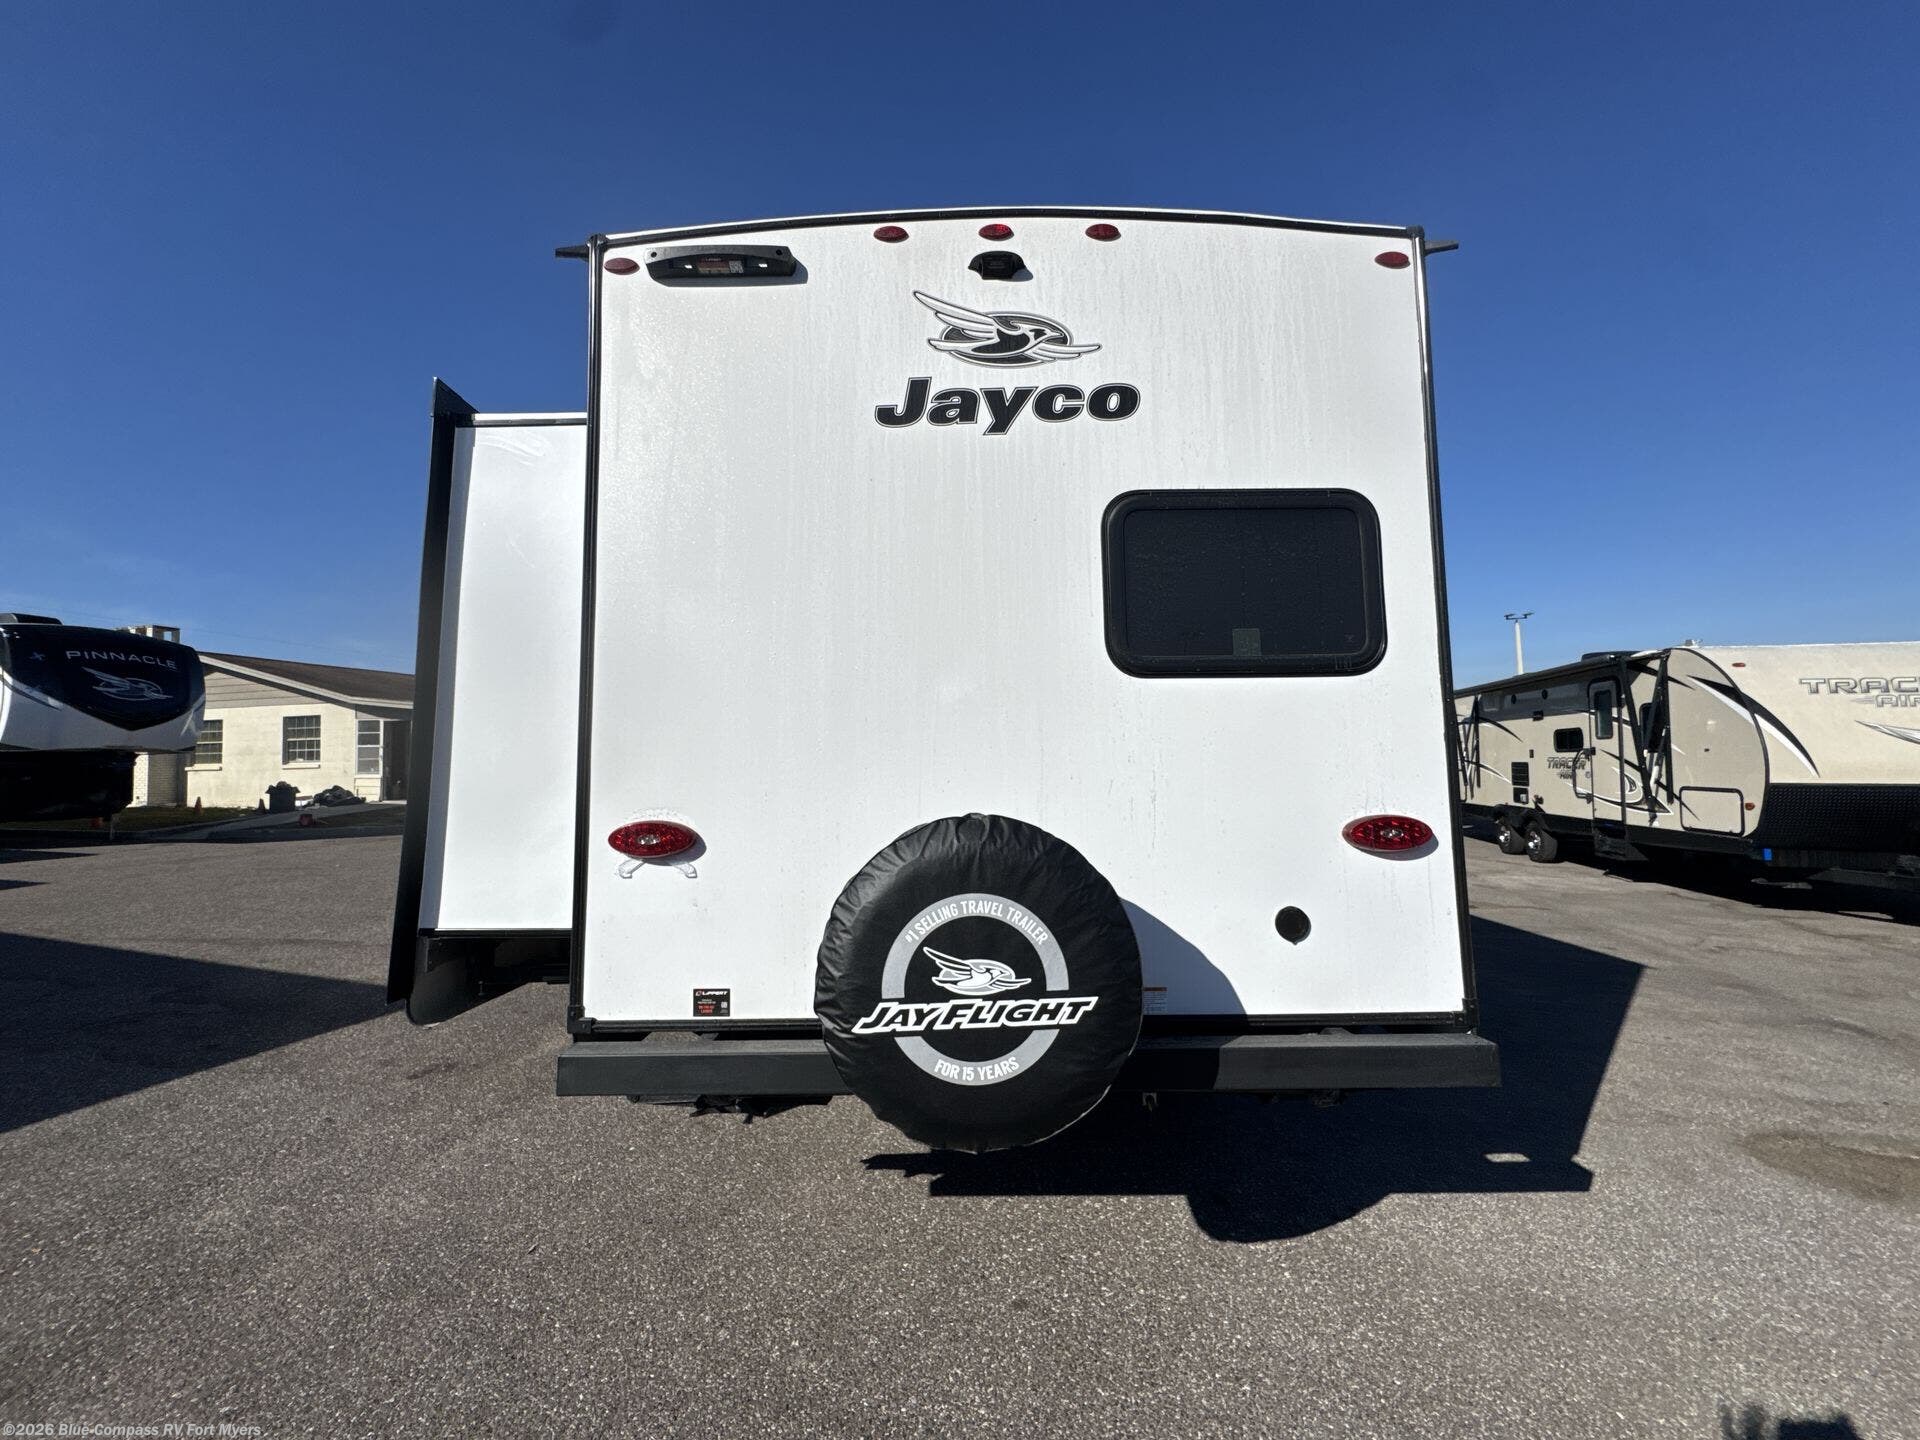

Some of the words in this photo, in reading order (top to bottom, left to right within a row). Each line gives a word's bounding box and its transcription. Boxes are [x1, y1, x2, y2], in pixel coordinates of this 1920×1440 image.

[874, 376, 1141, 436] Jayco
[65, 650, 177, 670] PINNACLE
[1799, 677, 1920, 694] TRAC
[905, 930, 919, 943] #1
[914, 904, 959, 935] SELLING
[960, 900, 1003, 917] TRAVEL
[1006, 906, 1048, 945] TRAILER
[935, 1059, 960, 1080] FOR
[962, 1067, 974, 1081] 15
[979, 1056, 1020, 1081] YEARS
